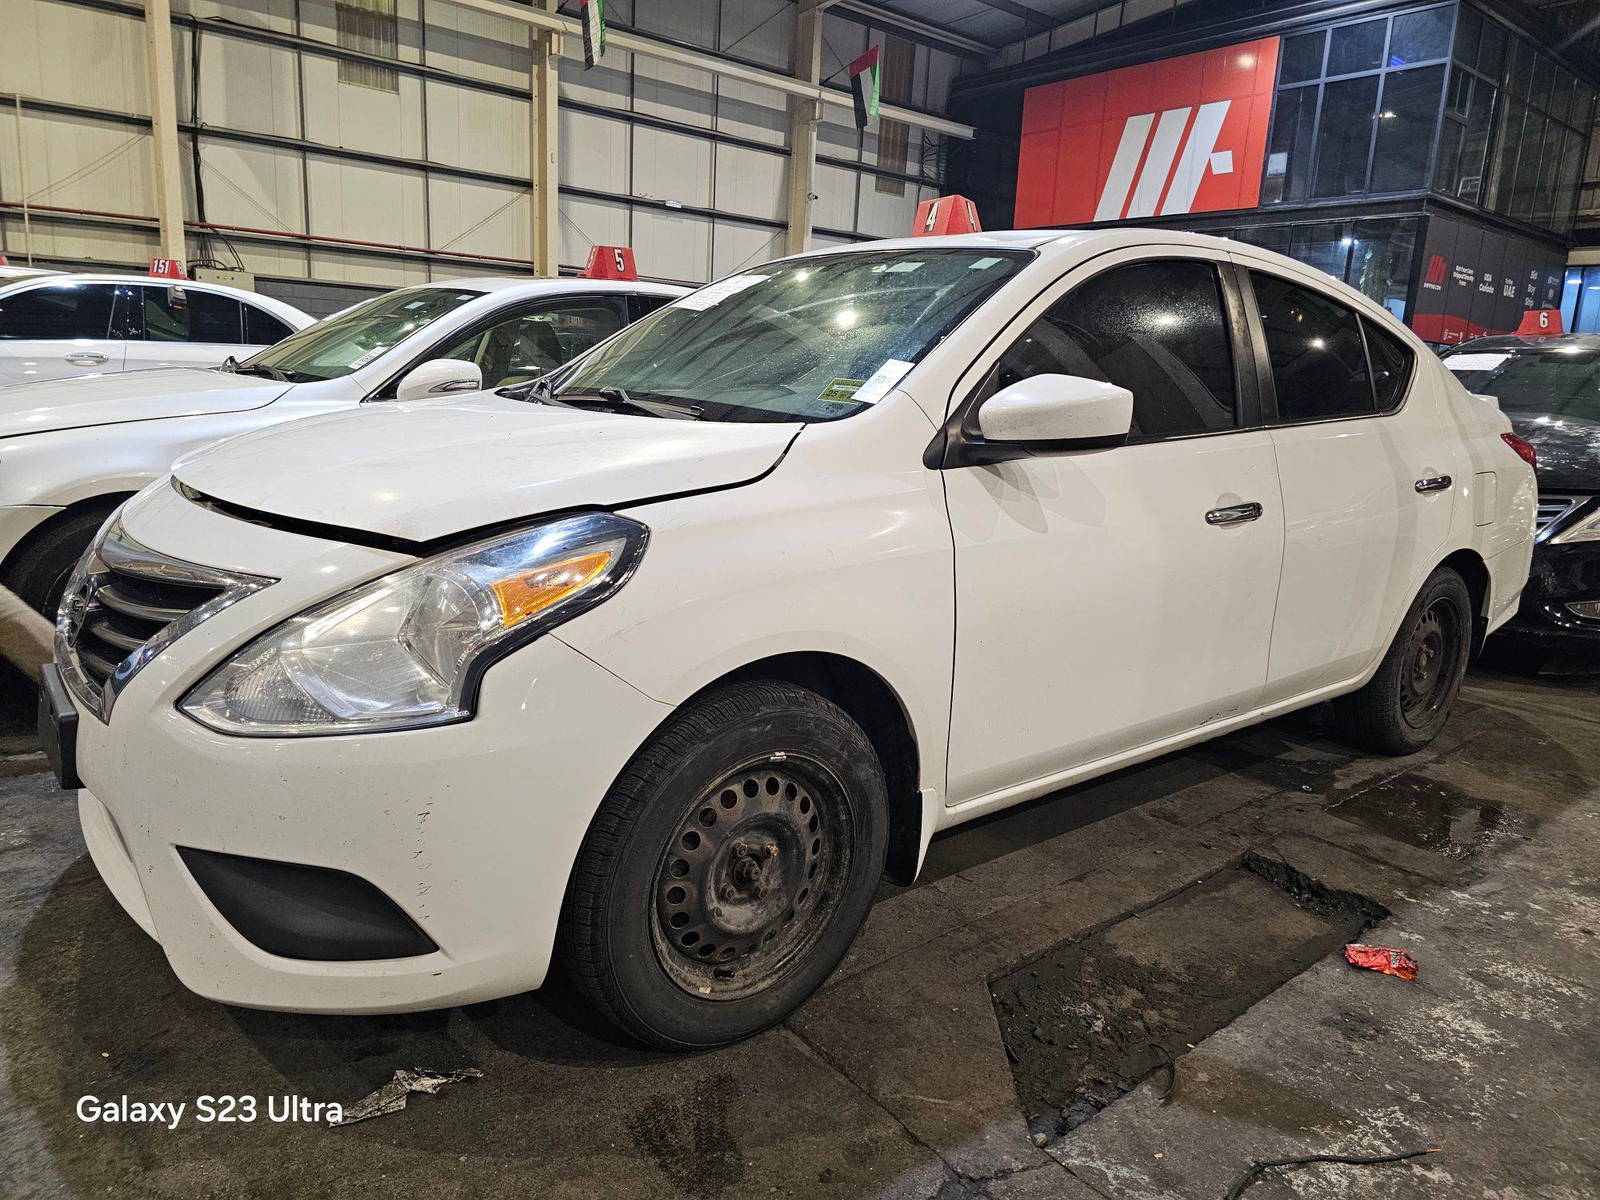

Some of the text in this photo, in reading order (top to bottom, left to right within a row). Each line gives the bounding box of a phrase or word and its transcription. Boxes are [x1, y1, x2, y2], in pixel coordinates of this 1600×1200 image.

[926, 201, 939, 231] 4
[153, 259, 170, 274] 151
[613, 248, 625, 271] 5
[1503, 284, 1516, 298] UAE
[1540, 311, 1549, 328] 6
